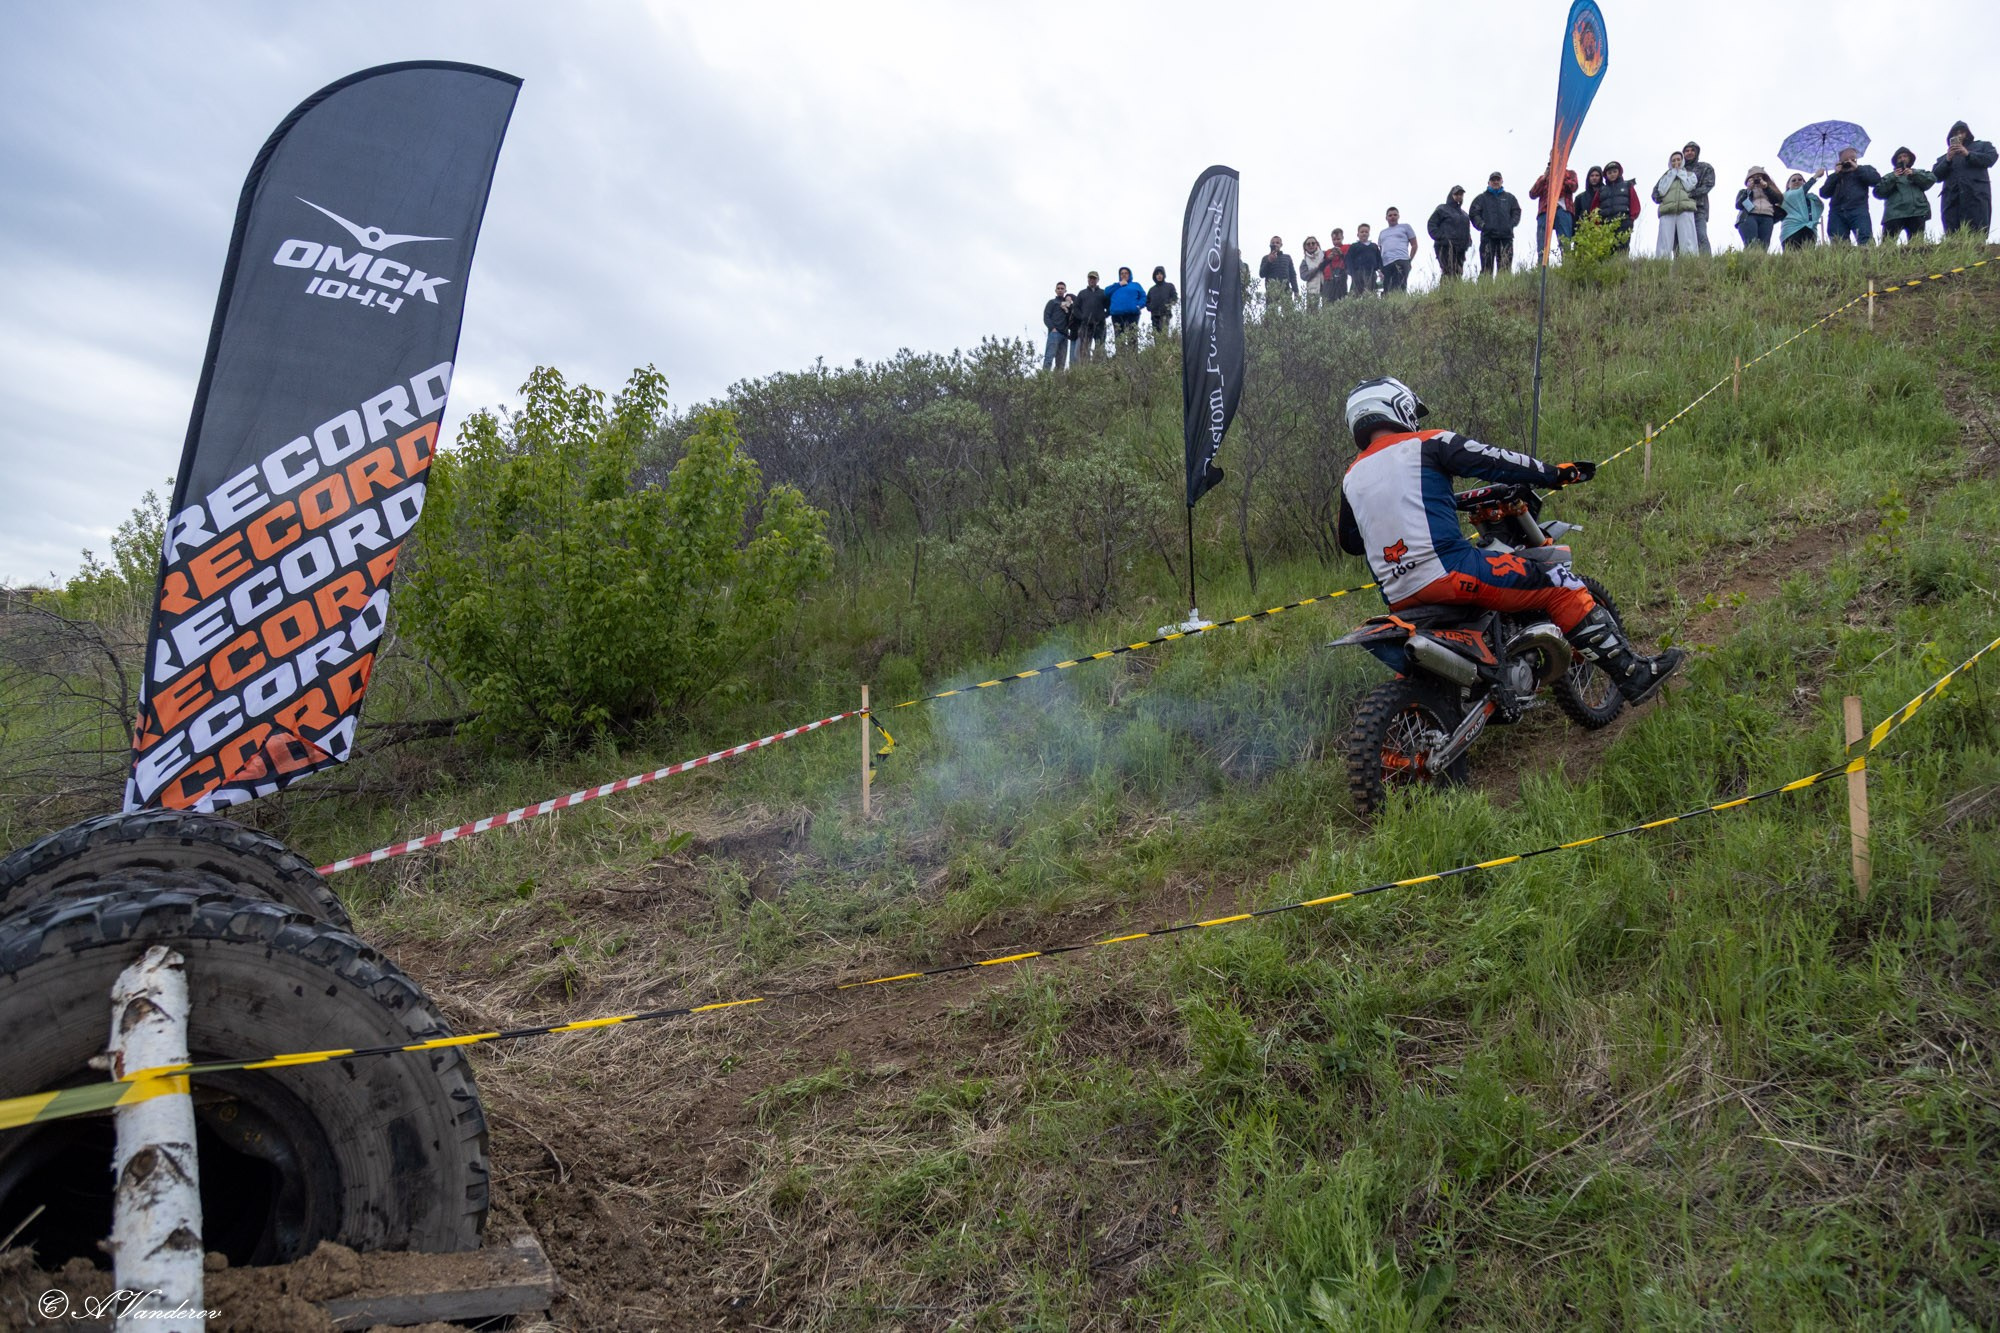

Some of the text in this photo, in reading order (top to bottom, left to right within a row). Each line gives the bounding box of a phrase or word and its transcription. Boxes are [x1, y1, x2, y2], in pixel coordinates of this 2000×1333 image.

[273, 239, 451, 304] ОМСК
[305, 276, 404, 314] 104.4
[161, 361, 454, 566] RECORD
[124, 589, 390, 812] ECORD
